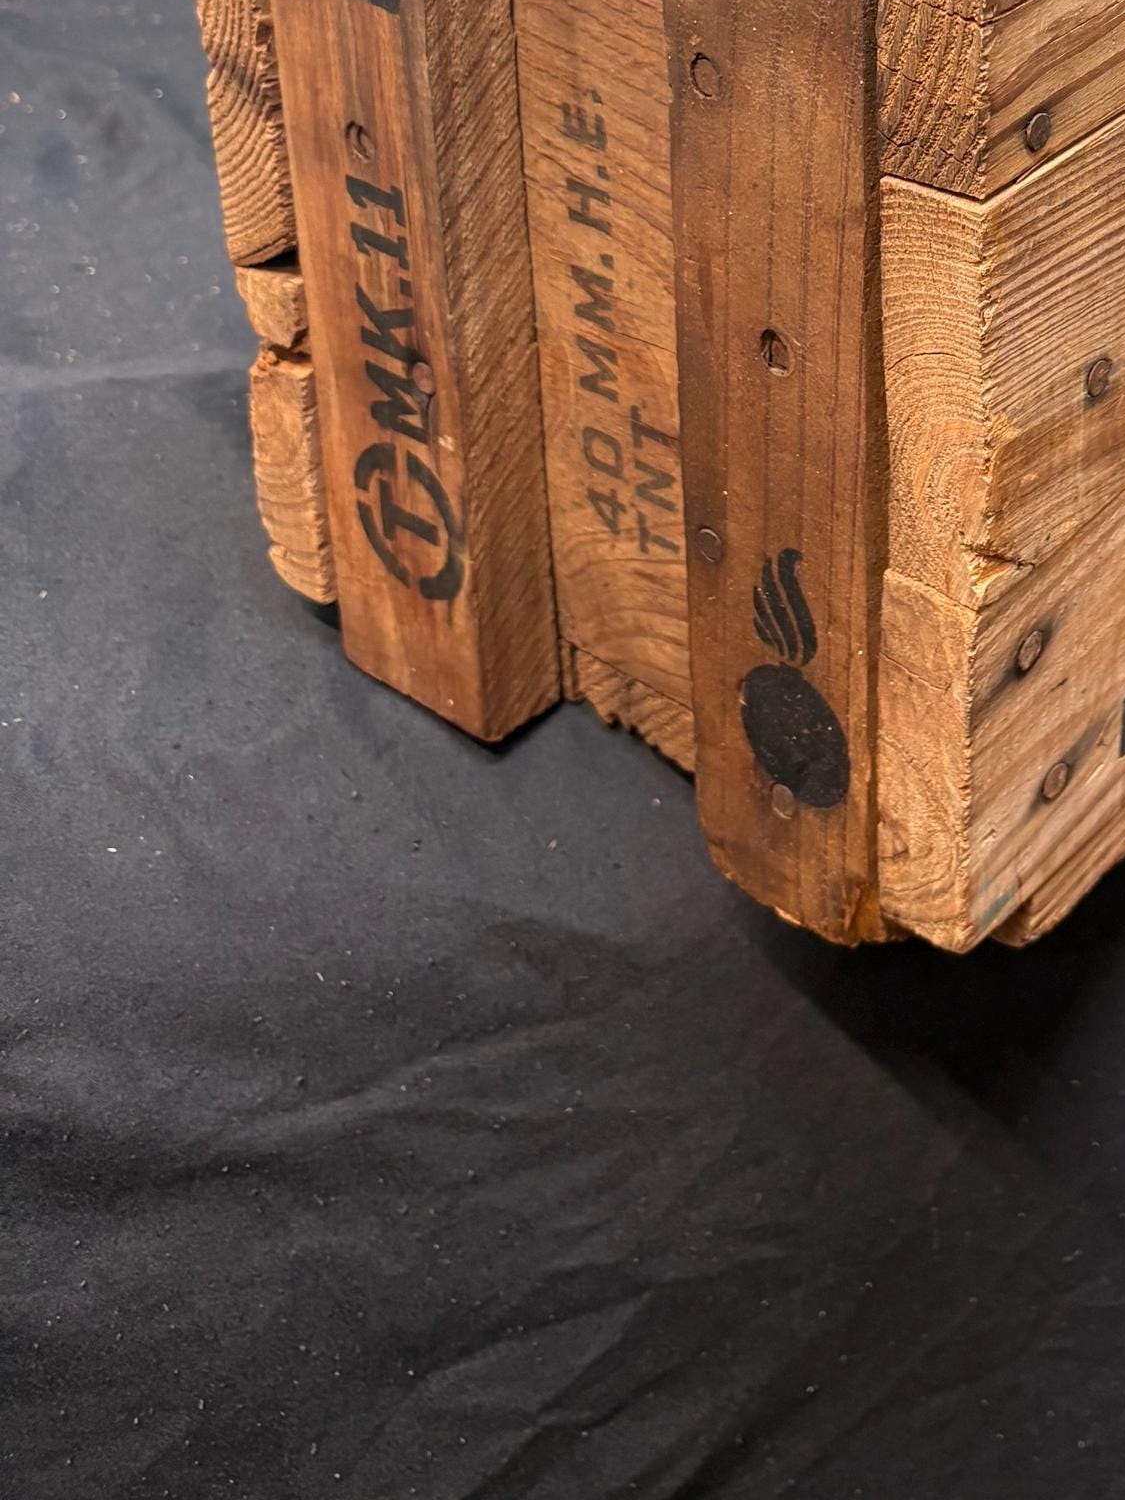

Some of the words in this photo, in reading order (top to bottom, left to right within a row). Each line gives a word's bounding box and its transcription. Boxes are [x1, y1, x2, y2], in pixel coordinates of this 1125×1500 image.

[345, 173, 431, 446] MK.11
[583, 427, 627, 538] 40
[630, 406, 682, 554] TNT
